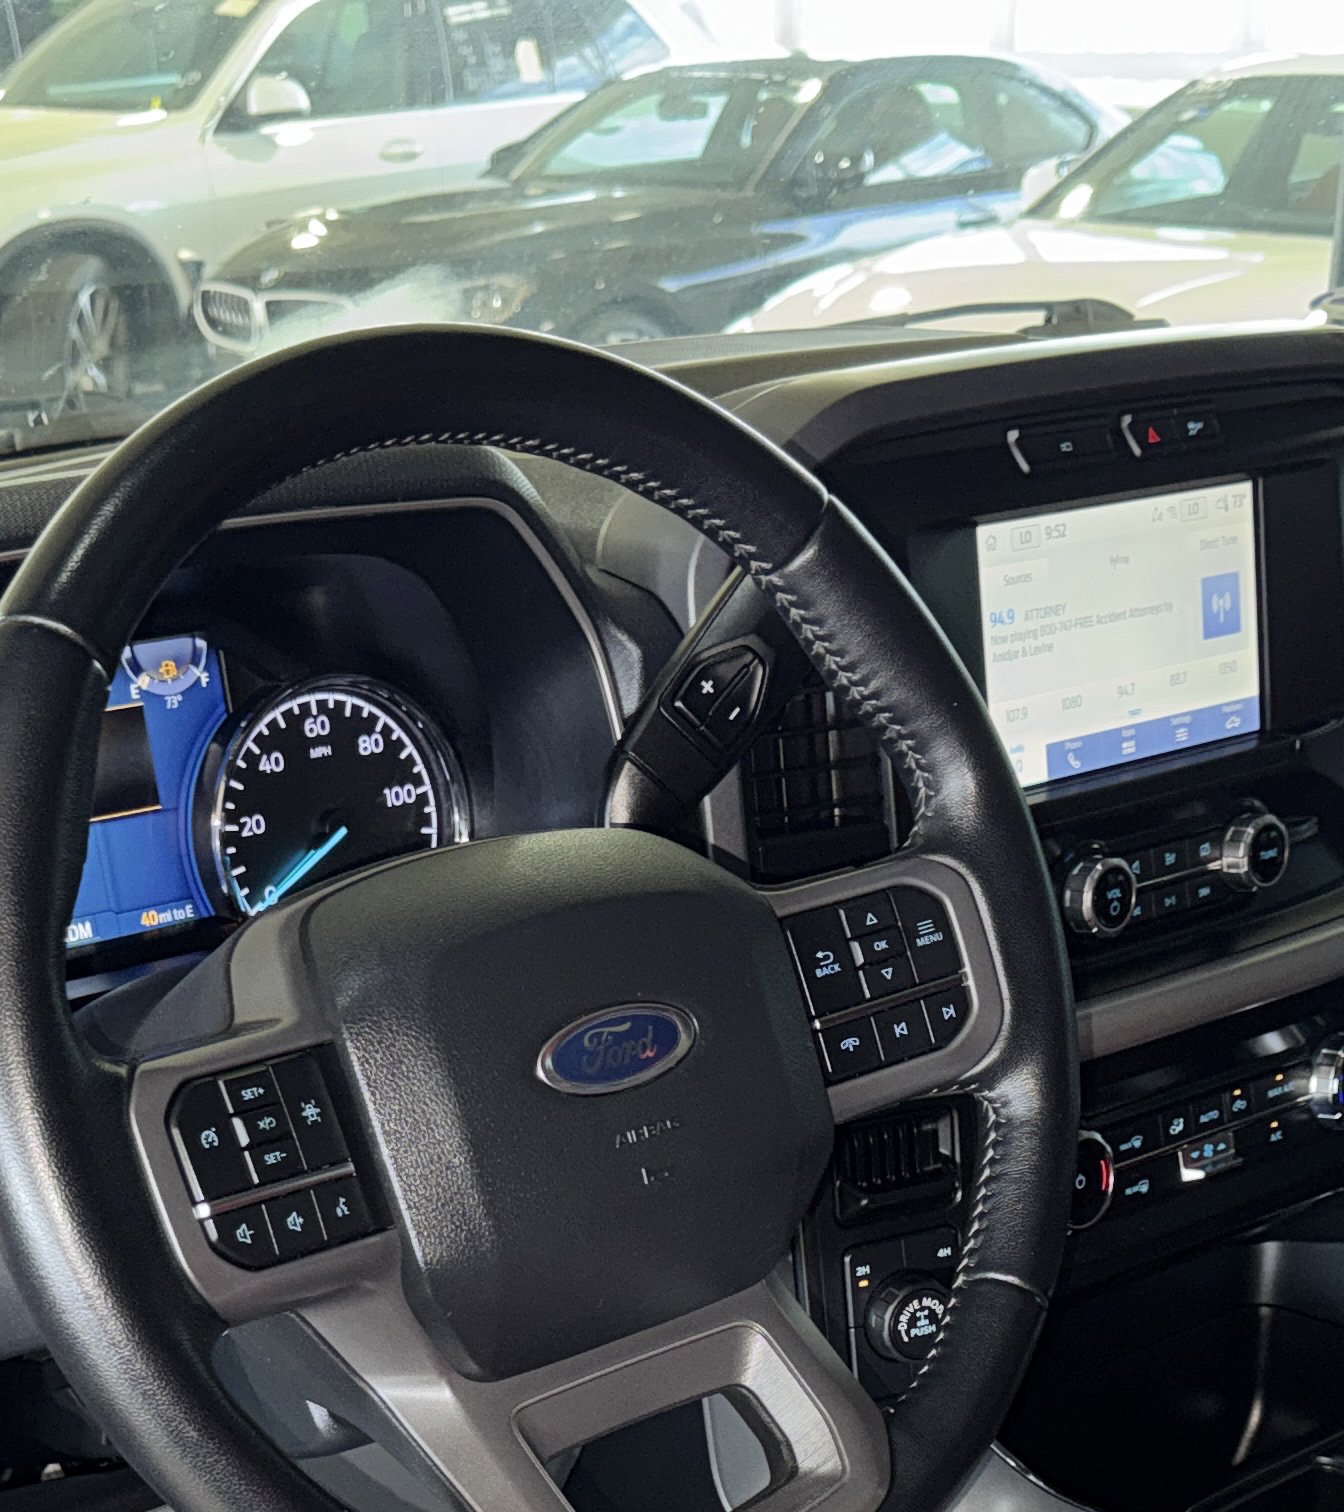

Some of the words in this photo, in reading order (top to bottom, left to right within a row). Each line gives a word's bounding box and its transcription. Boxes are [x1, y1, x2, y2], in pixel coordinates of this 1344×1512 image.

[1045, 524, 1067, 541] 9:52
[1003, 572, 1033, 587] Sources
[989, 608, 1016, 628] 94.9
[1024, 603, 1067, 622] ATTORNEY
[304, 715, 330, 738] 60
[309, 745, 332, 759] MPH
[358, 732, 384, 756] 80
[258, 751, 285, 774] 40
[382, 783, 416, 808] 100
[240, 814, 266, 837] 20
[140, 910, 159, 927] 40
[173, 908, 185, 921] to
[873, 939, 889, 951] OK
[915, 931, 944, 947] MENU
[815, 962, 841, 978] BACK
[581, 1021, 657, 1075] Ford
[937, 1246, 952, 1258] 4H
[856, 1264, 871, 1276] 2H
[897, 1299, 921, 1331] DRIVE
[910, 1324, 936, 1338] PUSH
